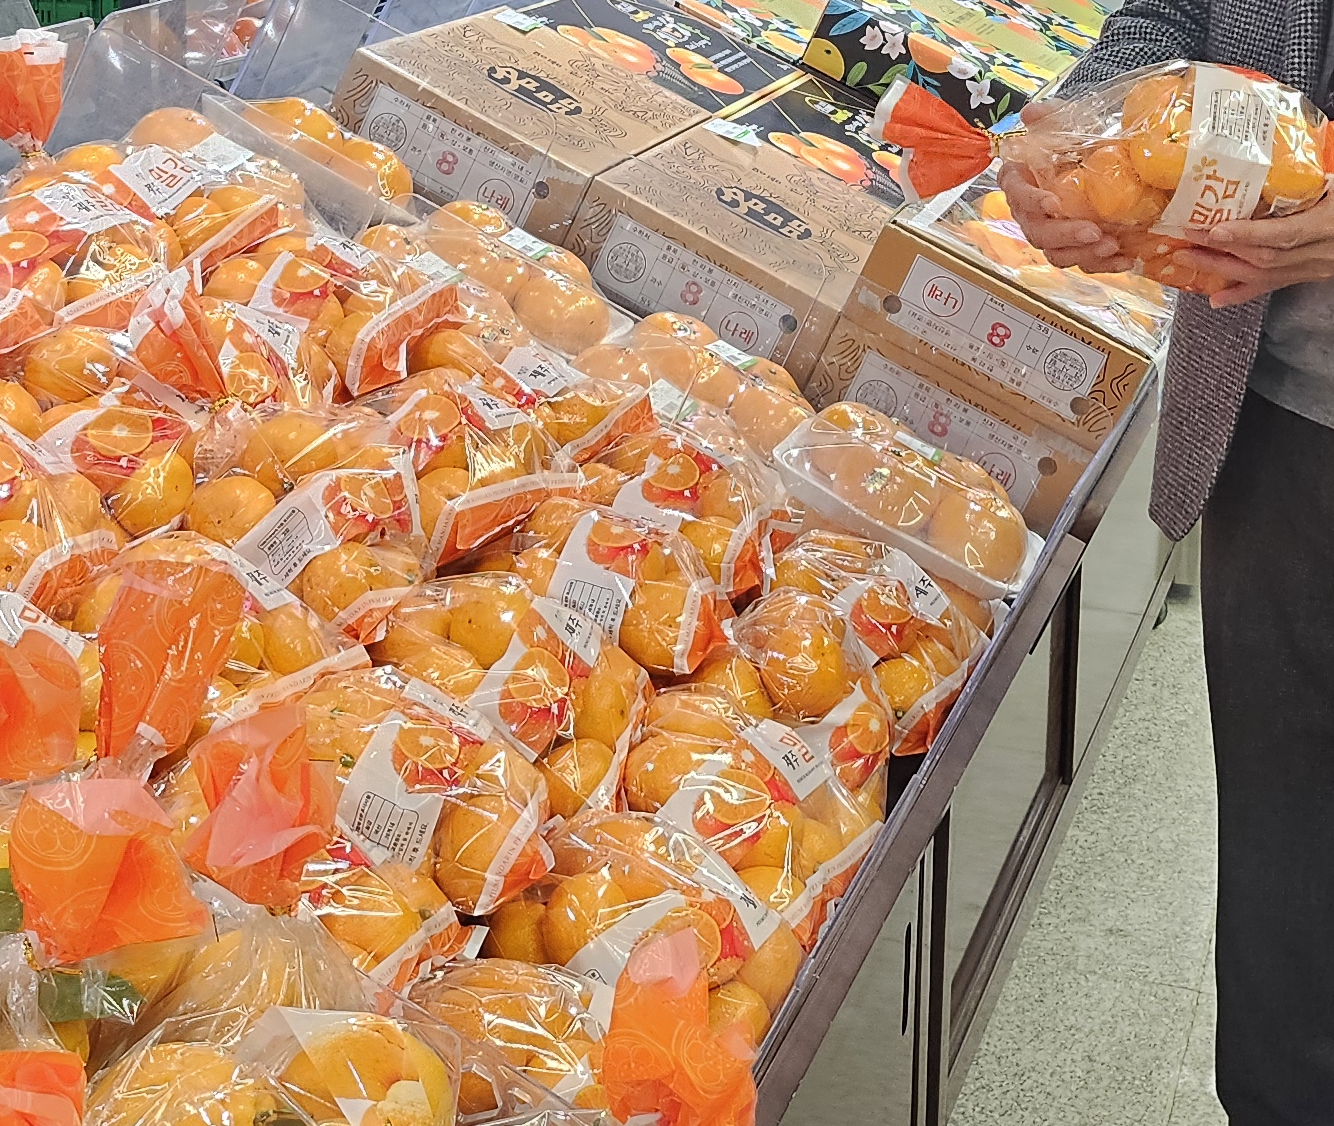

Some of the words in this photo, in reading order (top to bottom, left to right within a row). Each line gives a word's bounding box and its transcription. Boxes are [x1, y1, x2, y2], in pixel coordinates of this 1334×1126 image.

[436, 150, 459, 175] 8
[482, 185, 511, 211] 나래
[927, 283, 958, 310] 나래
[680, 280, 703, 306] 8
[724, 319, 755, 345] 나래
[987, 321, 1011, 348] 8
[928, 409, 951, 437] 8
[913, 576, 936, 598] 제주
[564, 613, 584, 637] 제주
